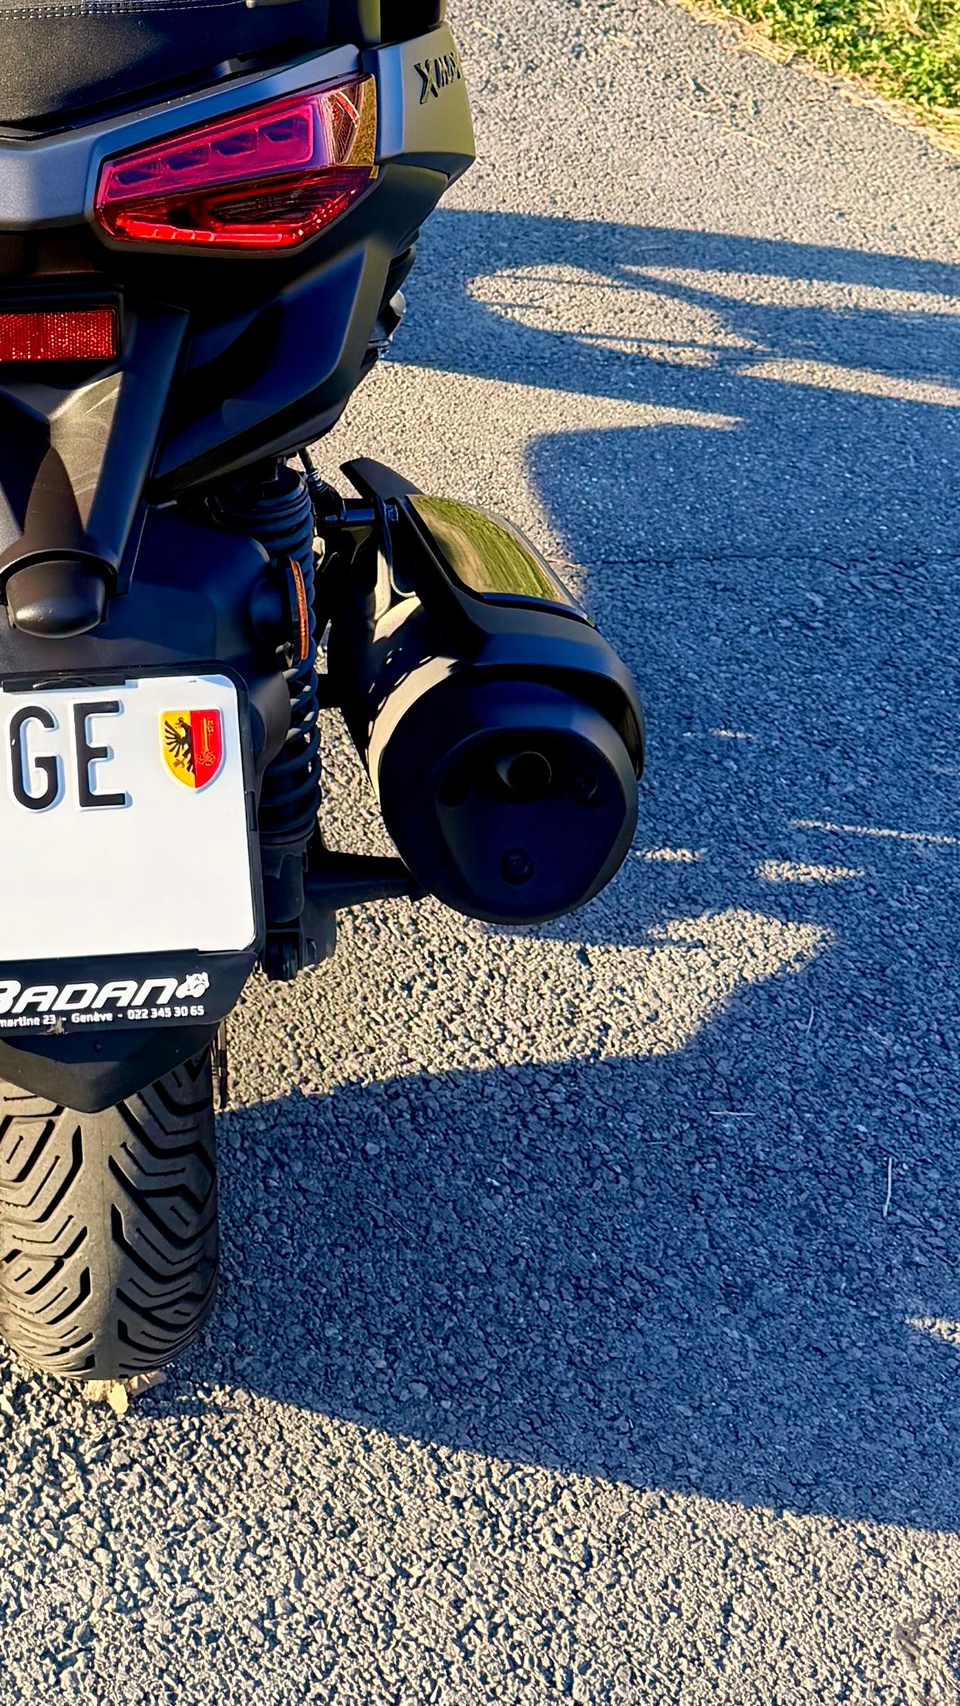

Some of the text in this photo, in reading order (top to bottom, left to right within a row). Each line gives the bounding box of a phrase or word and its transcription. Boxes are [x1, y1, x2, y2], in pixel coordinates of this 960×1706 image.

[9, 700, 127, 810] GE
[43, 1014, 56, 1025] 23
[71, 1011, 113, 1023] Genève
[127, 1008, 149, 1020] 022
[150, 1007, 171, 1019] 345
[174, 1006, 189, 1017] 30
[190, 1005, 205, 1016] 65
